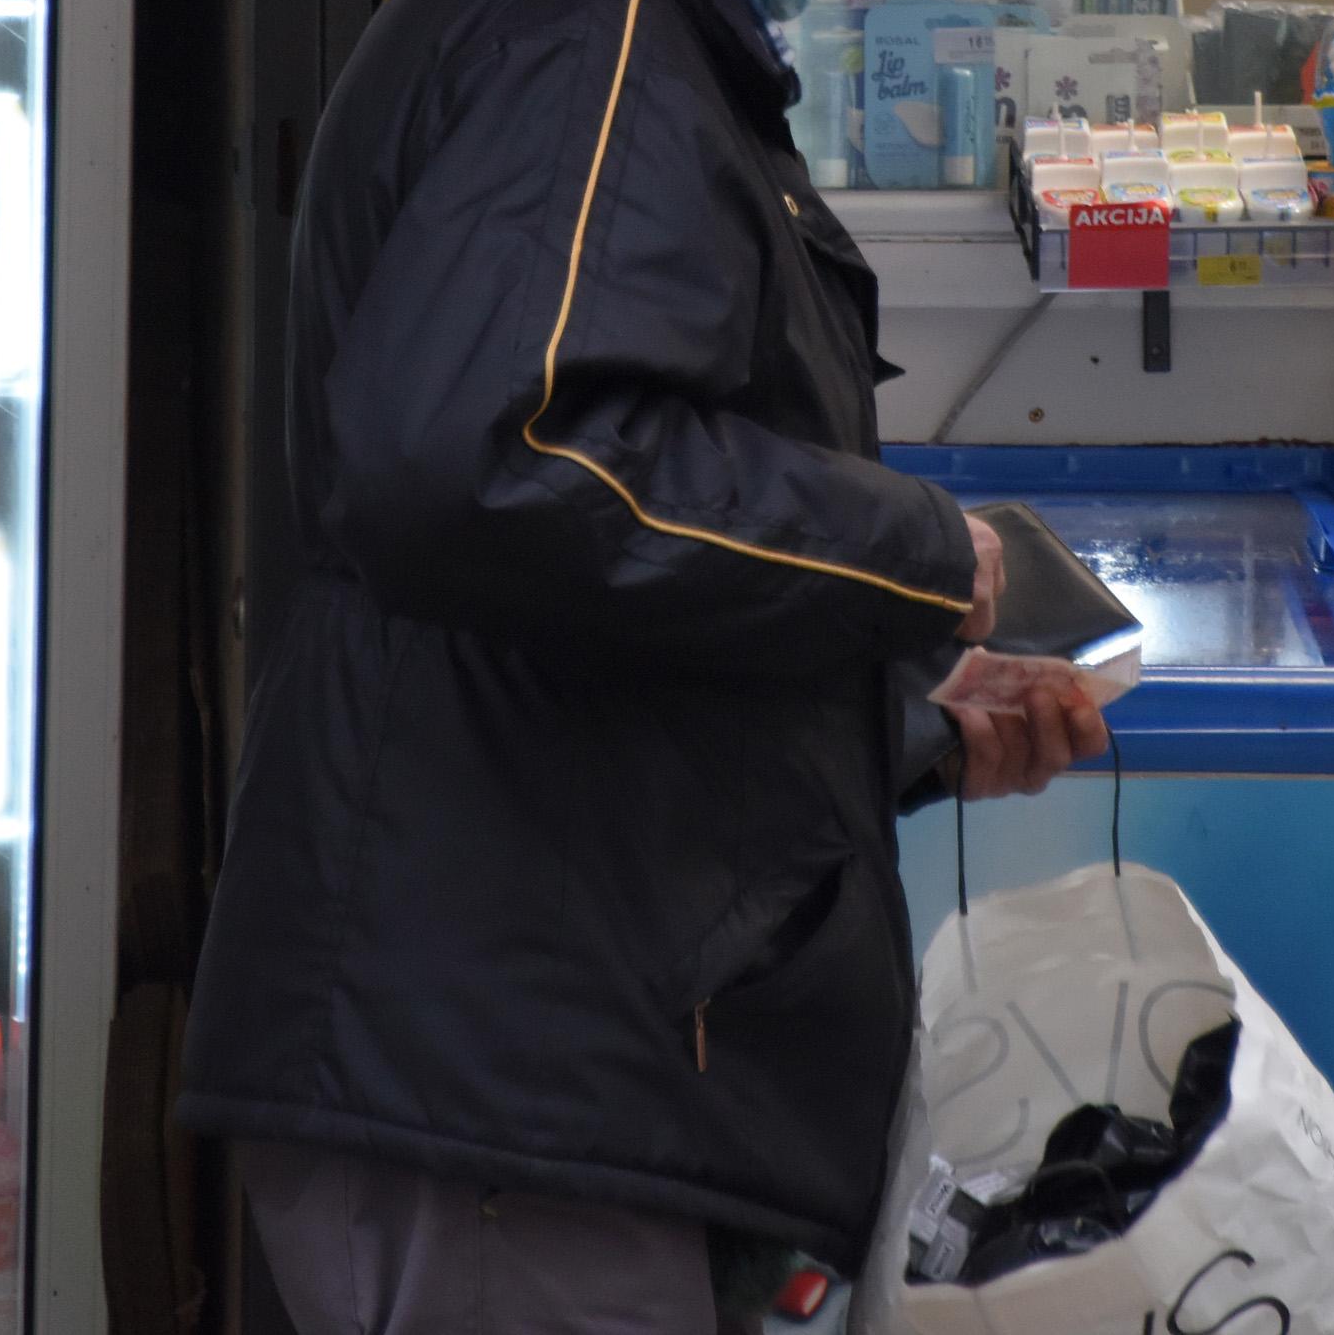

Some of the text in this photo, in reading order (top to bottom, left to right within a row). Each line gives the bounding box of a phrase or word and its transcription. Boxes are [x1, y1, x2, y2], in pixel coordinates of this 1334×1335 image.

[871, 50, 905, 81] Lip
[876, 74, 929, 101] balm
[1074, 206, 1166, 229] AKCIJA
